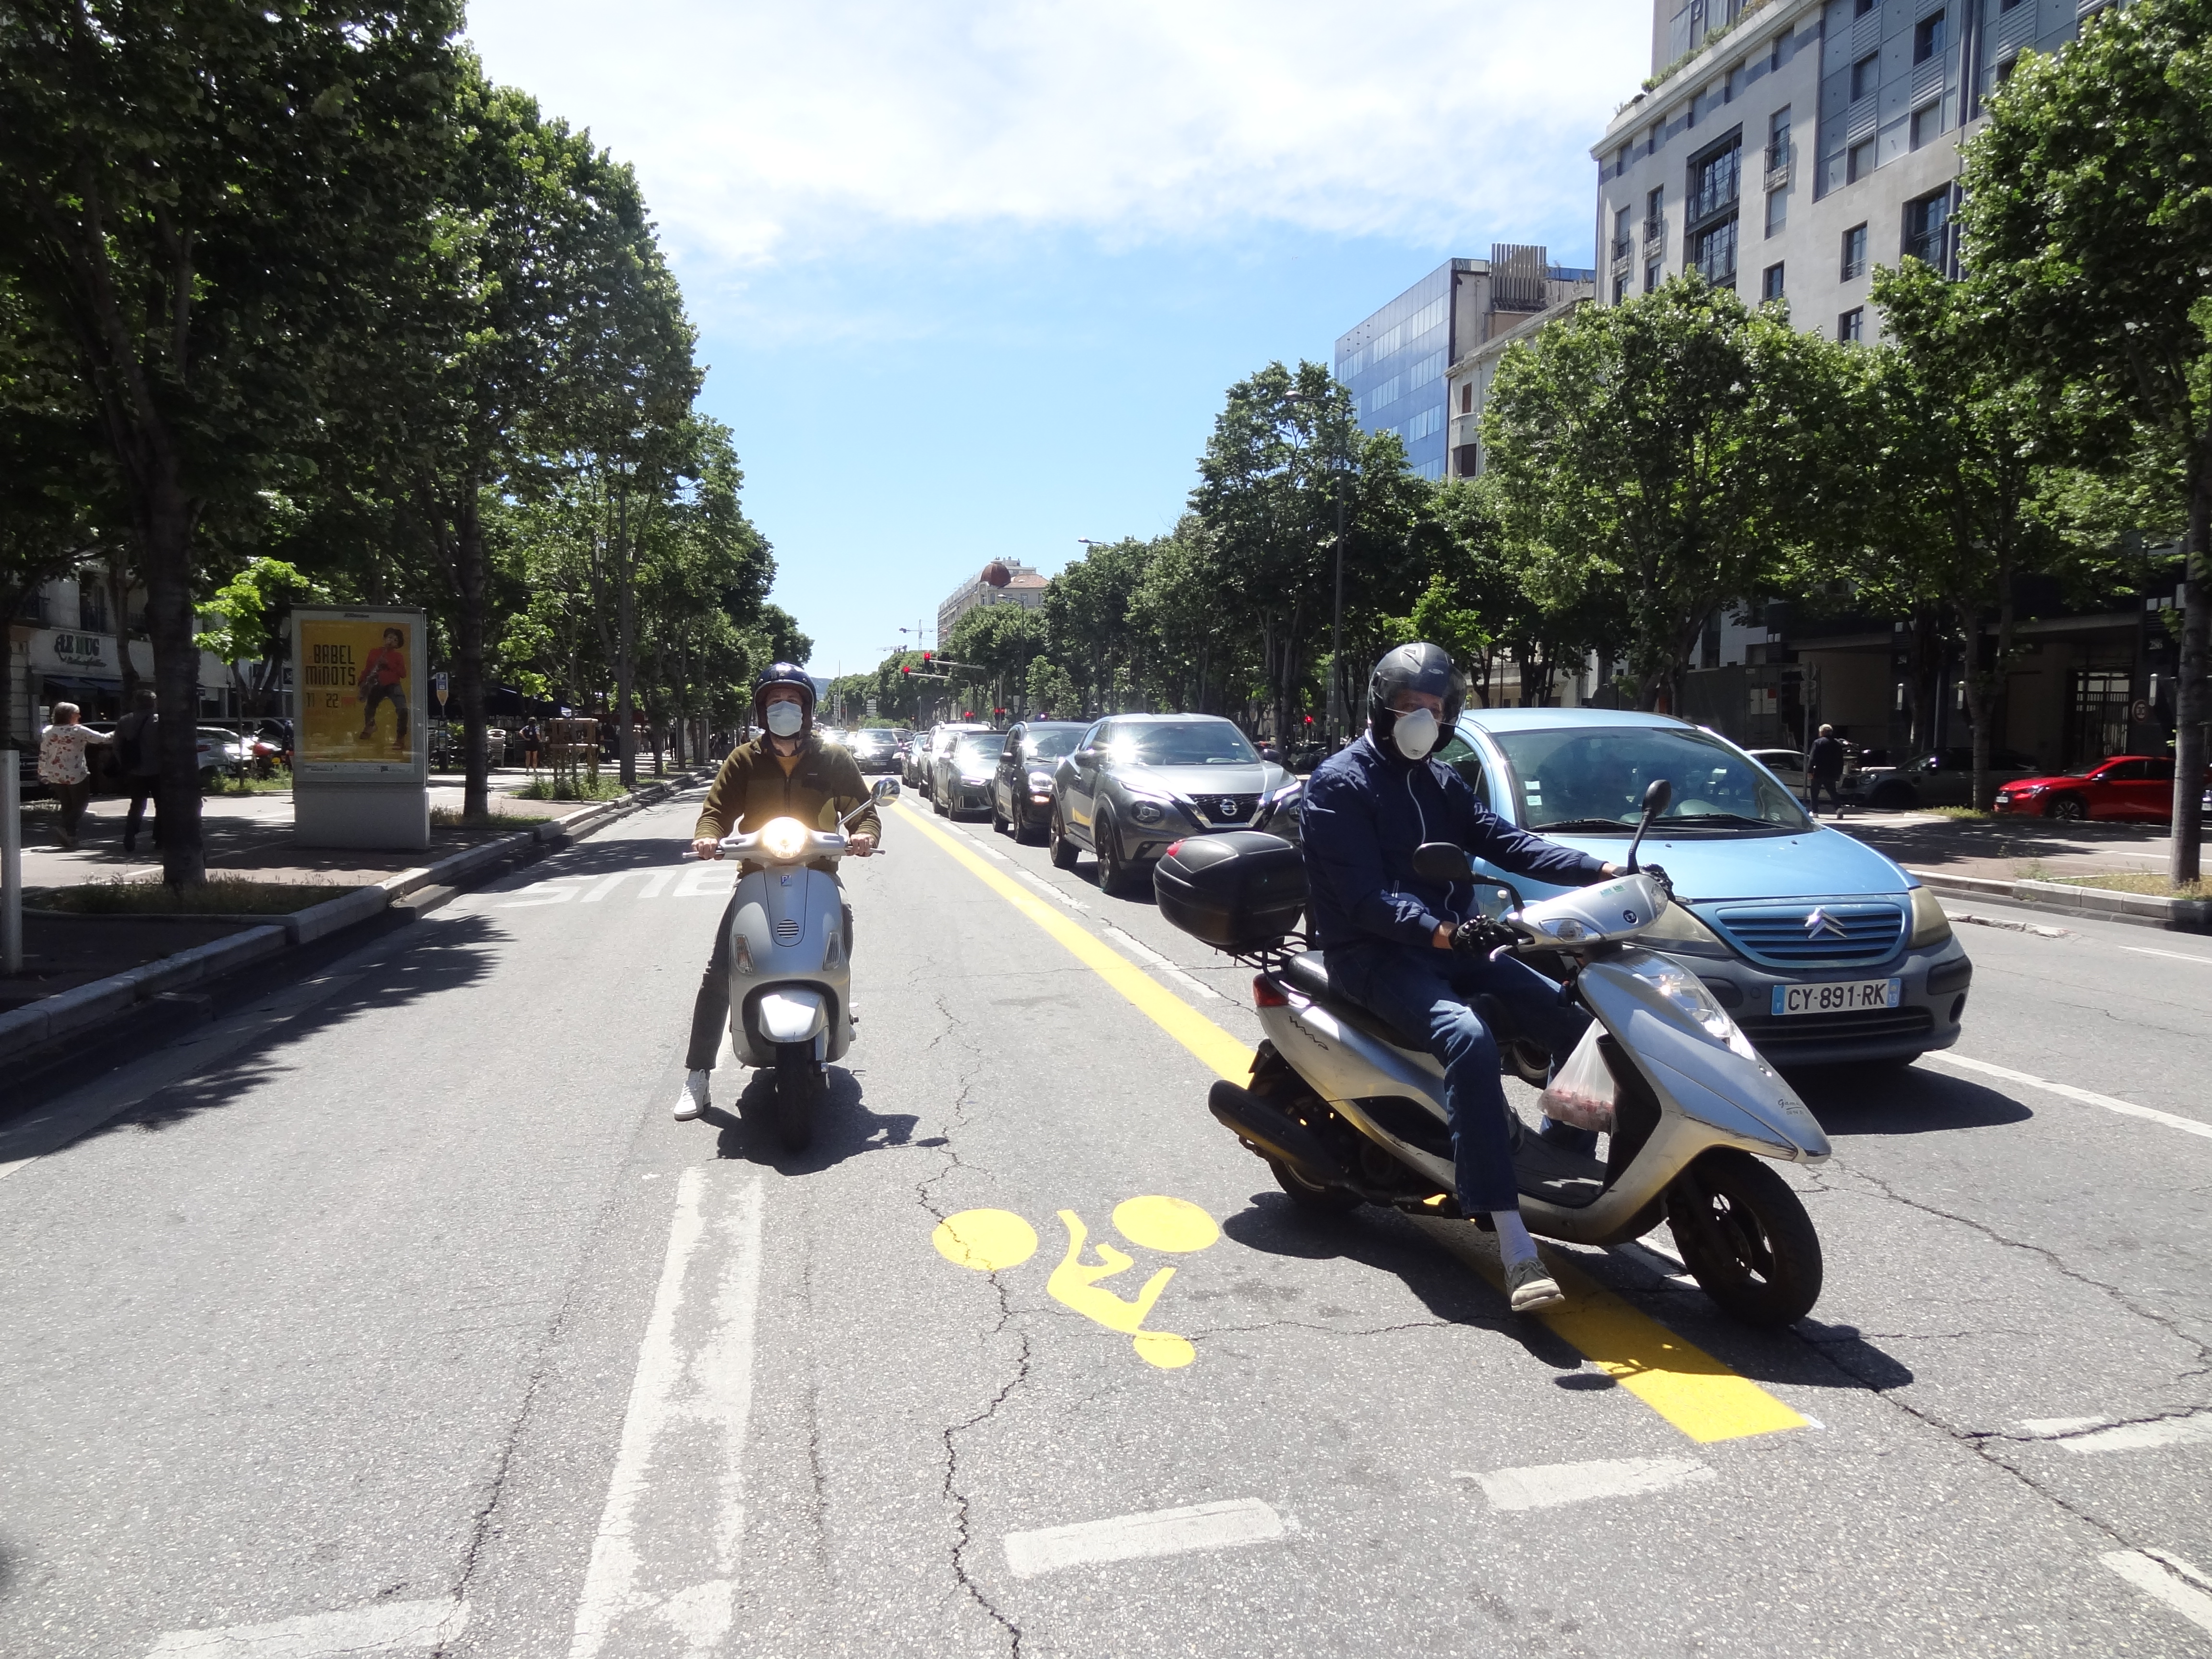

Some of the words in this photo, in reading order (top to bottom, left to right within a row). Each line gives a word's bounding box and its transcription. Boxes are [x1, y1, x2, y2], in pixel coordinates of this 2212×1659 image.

[313, 644, 355, 664] BABEL
[326, 693, 338, 708] 22
[1788, 983, 1887, 1010] CY-891-RK
